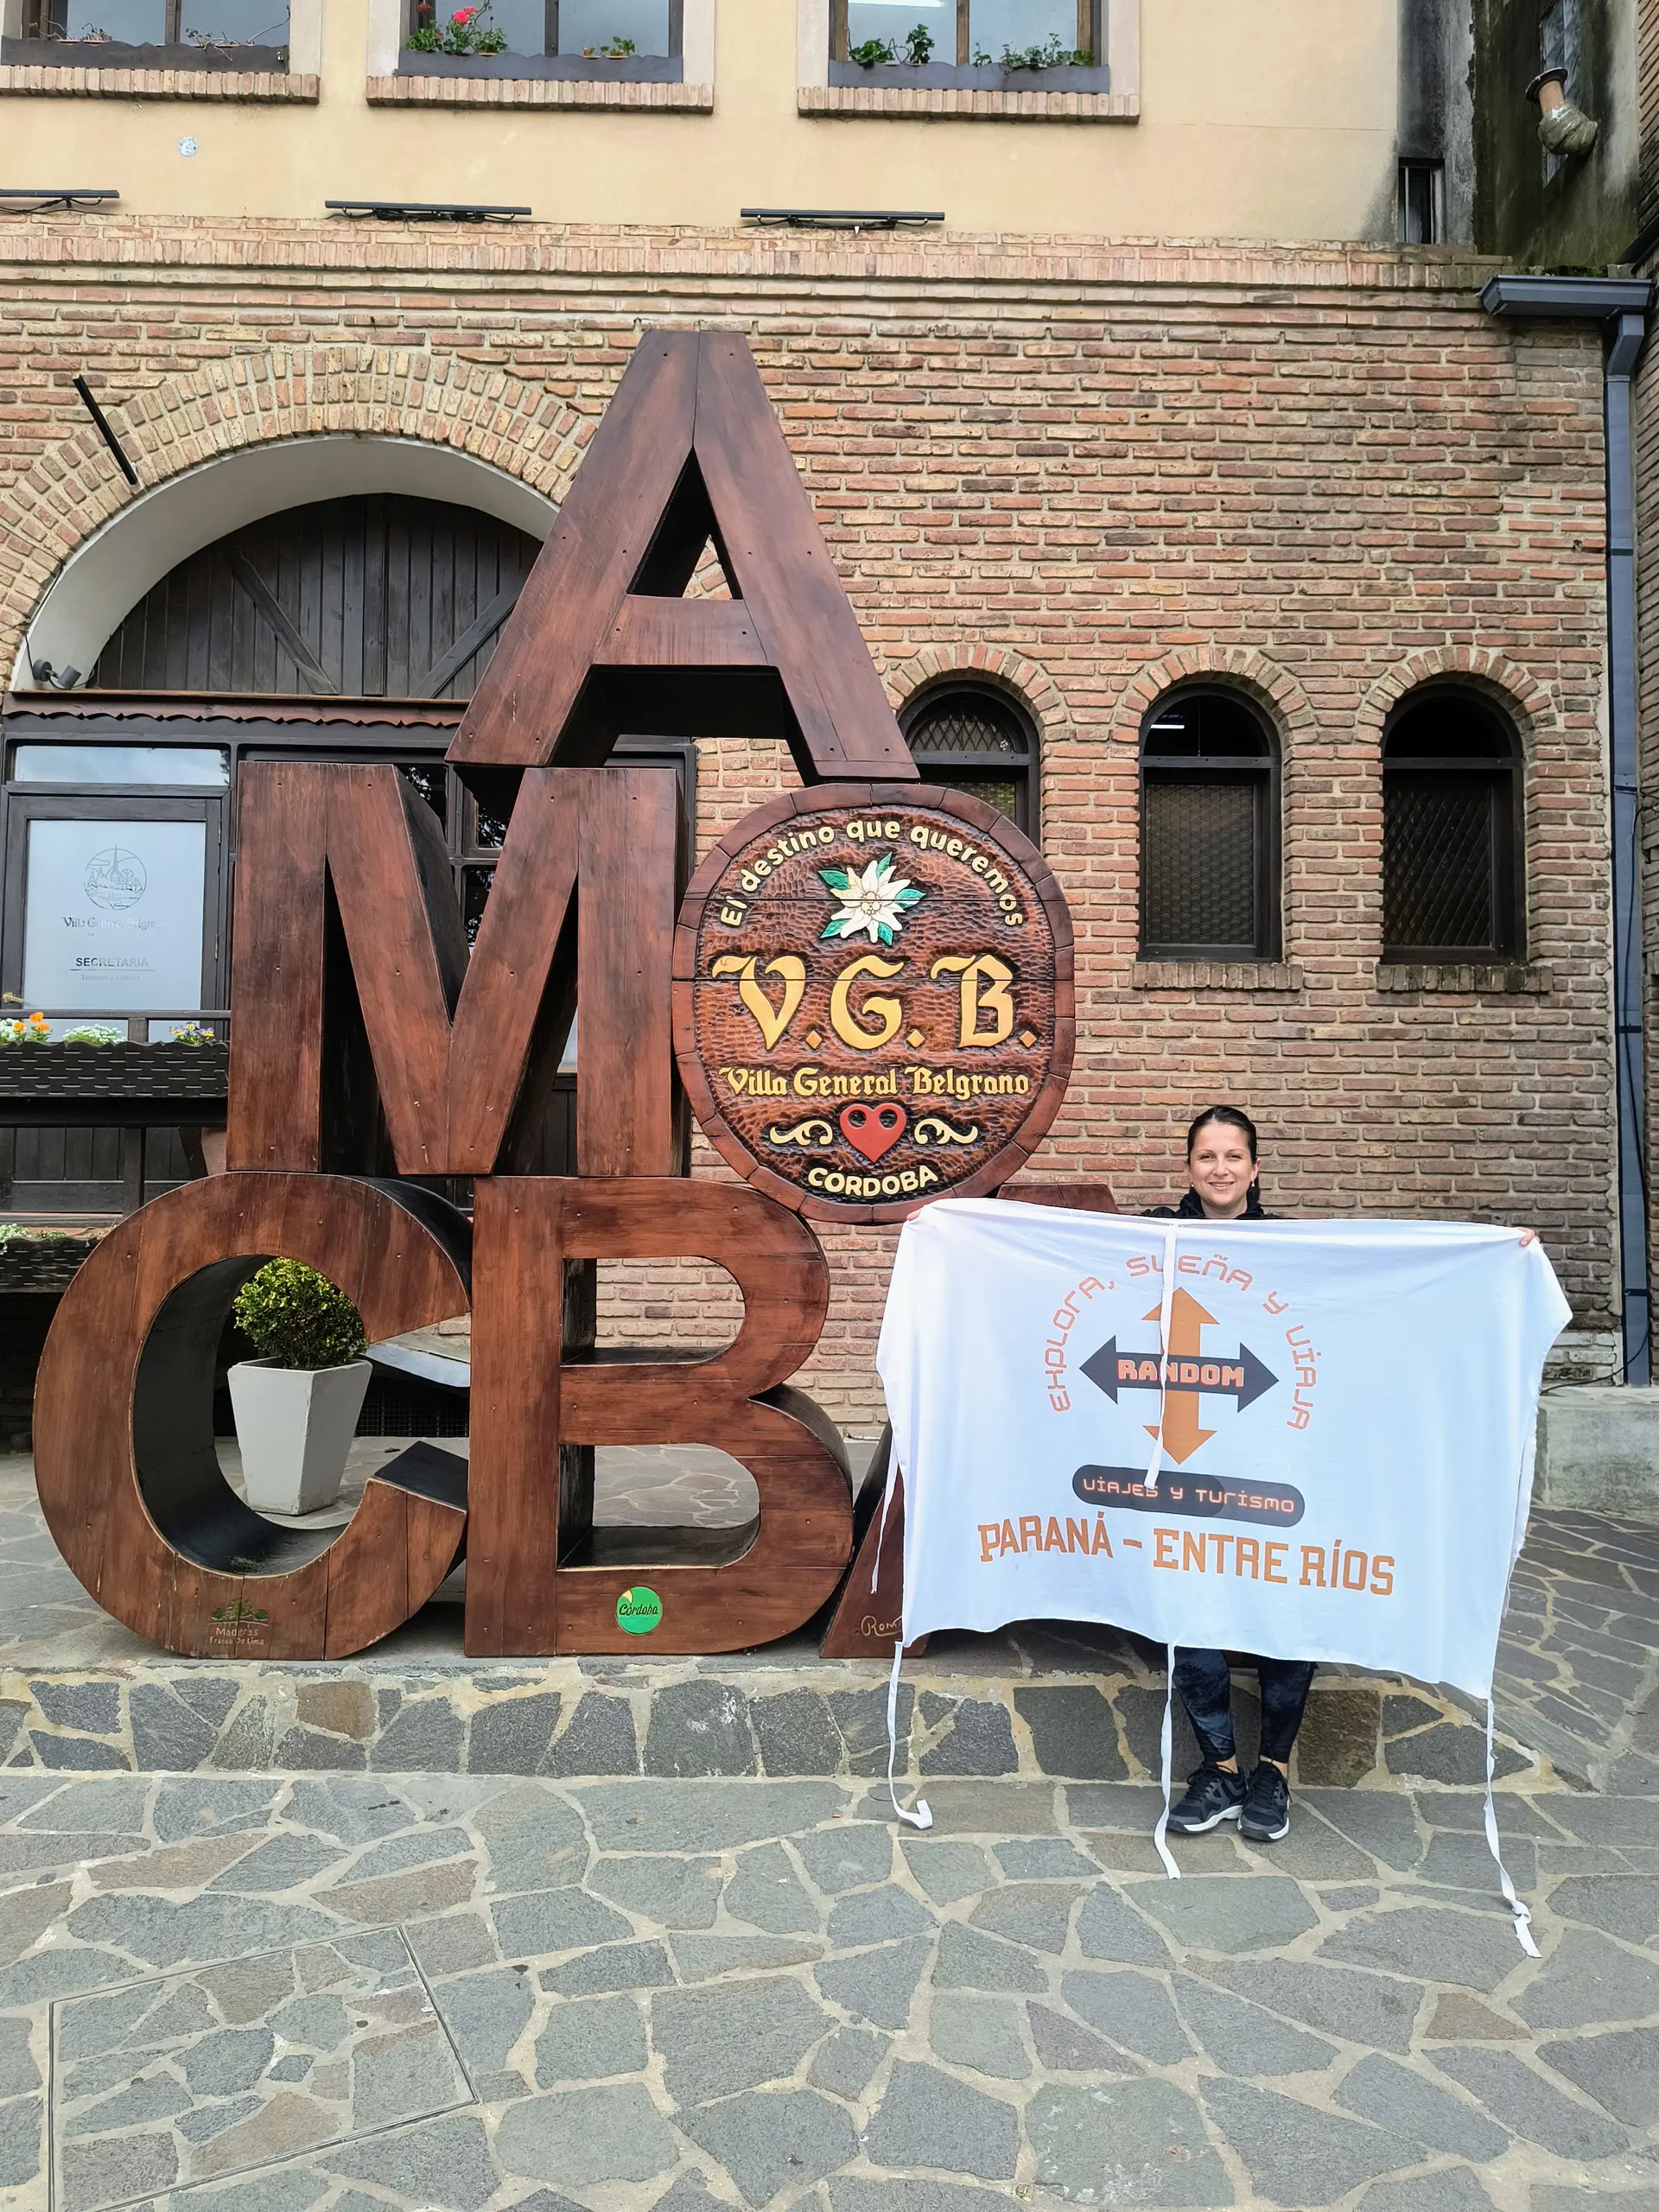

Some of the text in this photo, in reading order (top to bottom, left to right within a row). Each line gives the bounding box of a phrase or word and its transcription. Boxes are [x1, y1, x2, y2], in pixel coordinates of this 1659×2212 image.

[446, 331, 920, 783] A
[719, 820, 1024, 927] El destino que queremos
[75, 957, 149, 968] SECRETARIA
[718, 1066, 1030, 1101] Villa General Belgrano
[807, 1165, 939, 1198] CÓRDOBA
[1117, 1359, 1245, 1388] RANDOM
[977, 1511, 1114, 1562] PARANÁ
[1153, 1528, 1290, 1585] ENTRE
[1299, 1539, 1395, 1596] RÍOS
